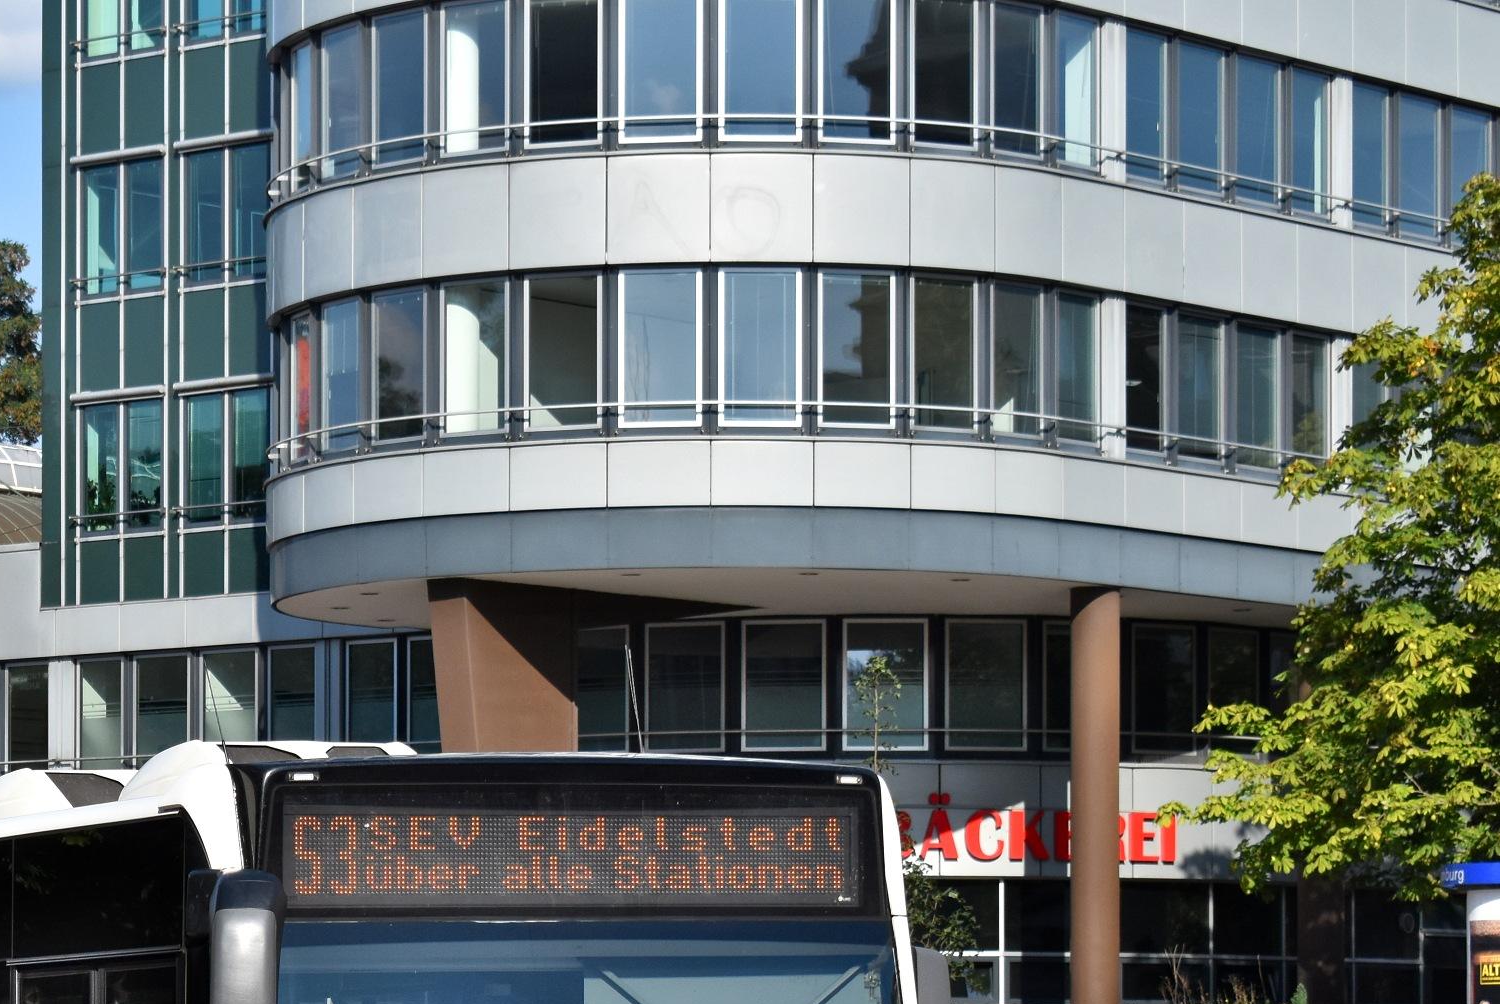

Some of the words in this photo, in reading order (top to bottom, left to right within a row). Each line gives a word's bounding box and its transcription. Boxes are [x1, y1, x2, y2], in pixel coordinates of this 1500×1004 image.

[368, 815, 481, 851] SEV
[518, 815, 841, 851] Eidelstedt
[365, 855, 481, 890] über
[502, 855, 593, 889] alle
[613, 855, 843, 889] Stationen
